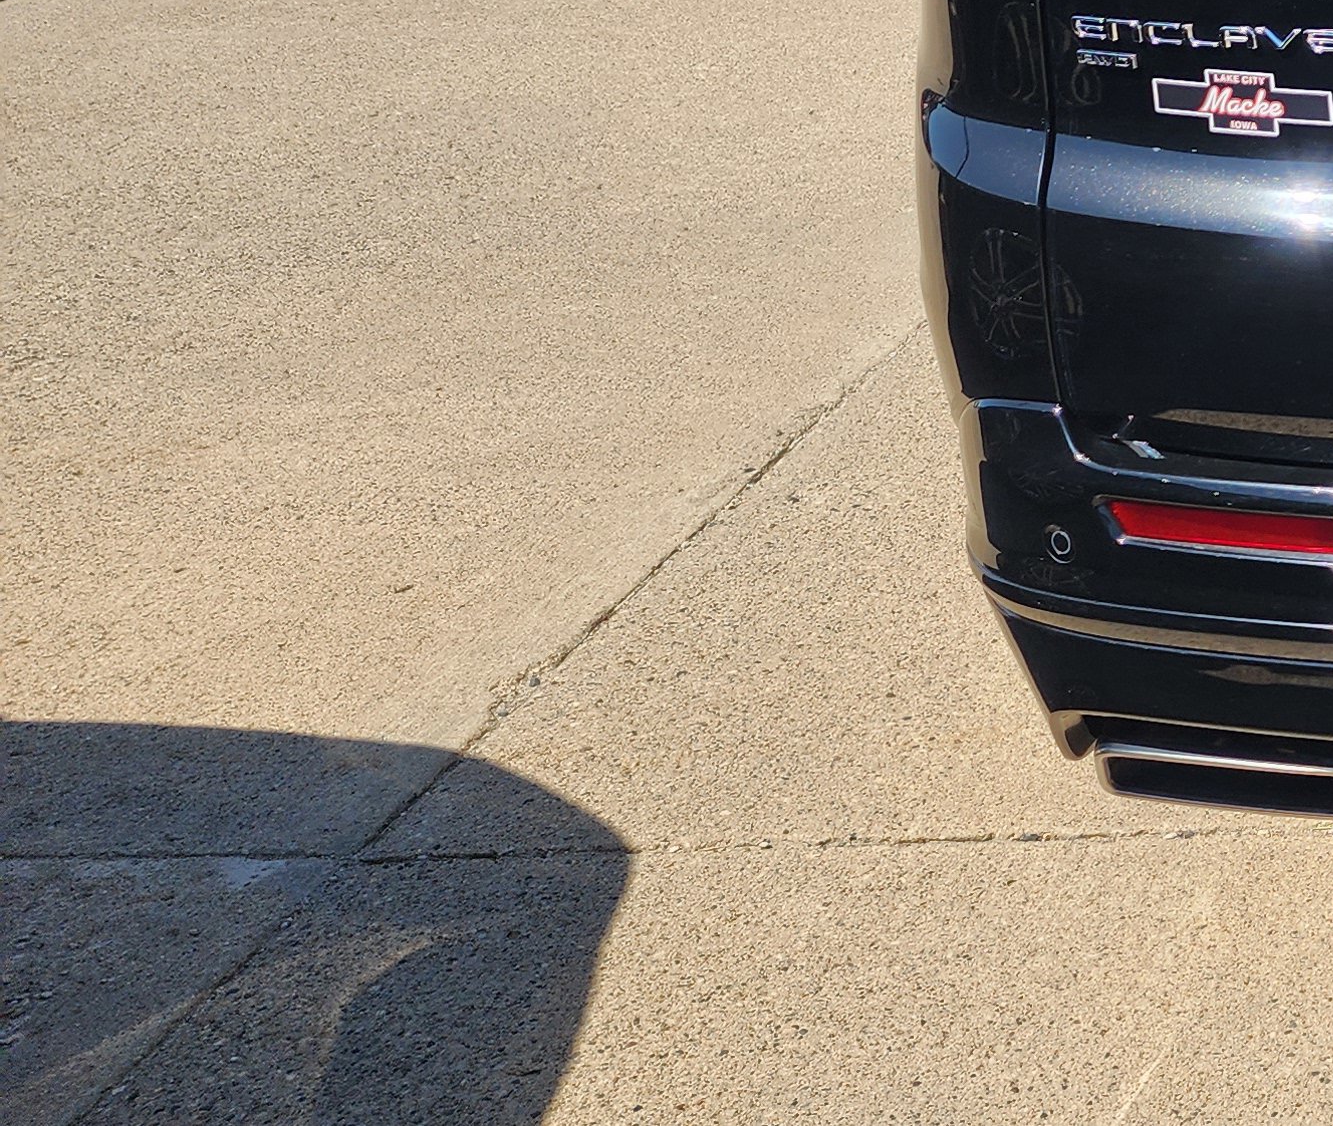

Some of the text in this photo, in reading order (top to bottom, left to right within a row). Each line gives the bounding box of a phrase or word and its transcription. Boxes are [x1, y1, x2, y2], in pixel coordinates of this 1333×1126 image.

[1213, 74, 1266, 86] LAKE CITY
[1198, 85, 1285, 117] Macke
[1229, 119, 1258, 130] IOWA
